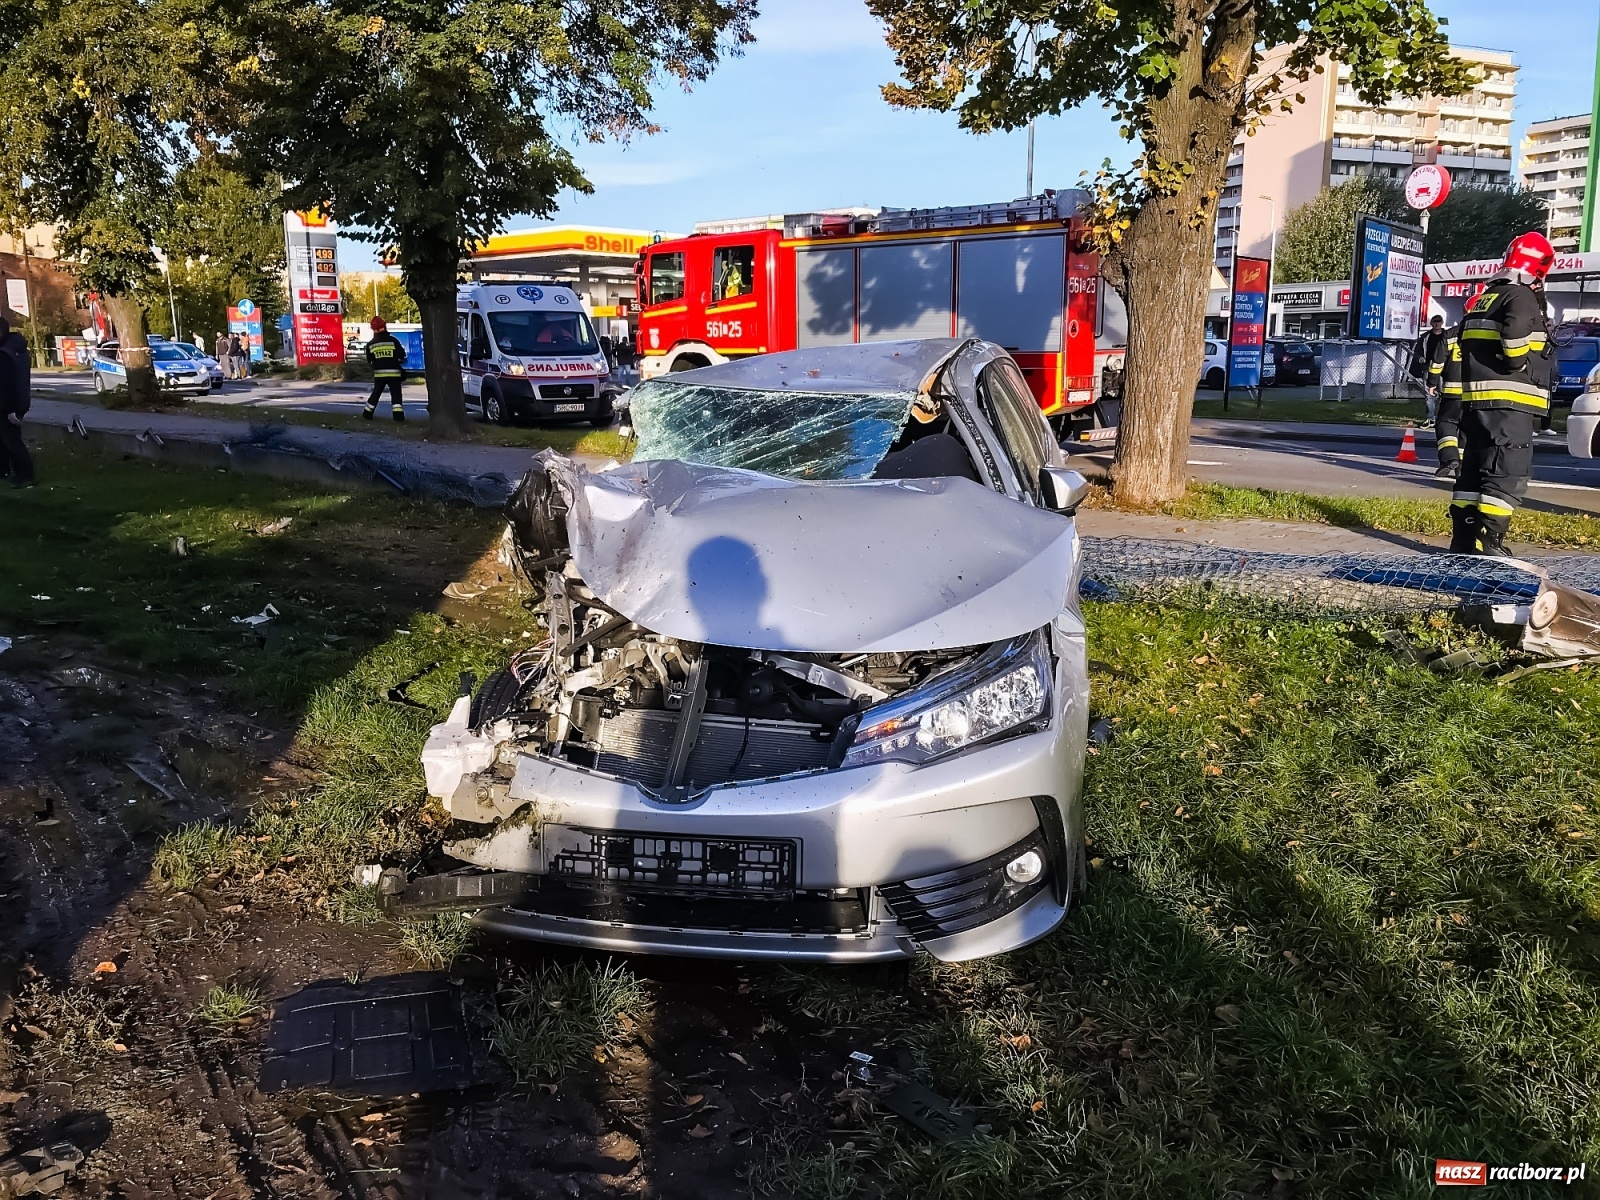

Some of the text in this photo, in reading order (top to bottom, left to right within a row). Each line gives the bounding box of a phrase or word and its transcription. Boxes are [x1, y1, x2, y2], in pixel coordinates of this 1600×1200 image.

[585, 235, 634, 253] Shell
[1556, 257, 1584, 270] 24h
[306, 303, 336, 313] deli2go
